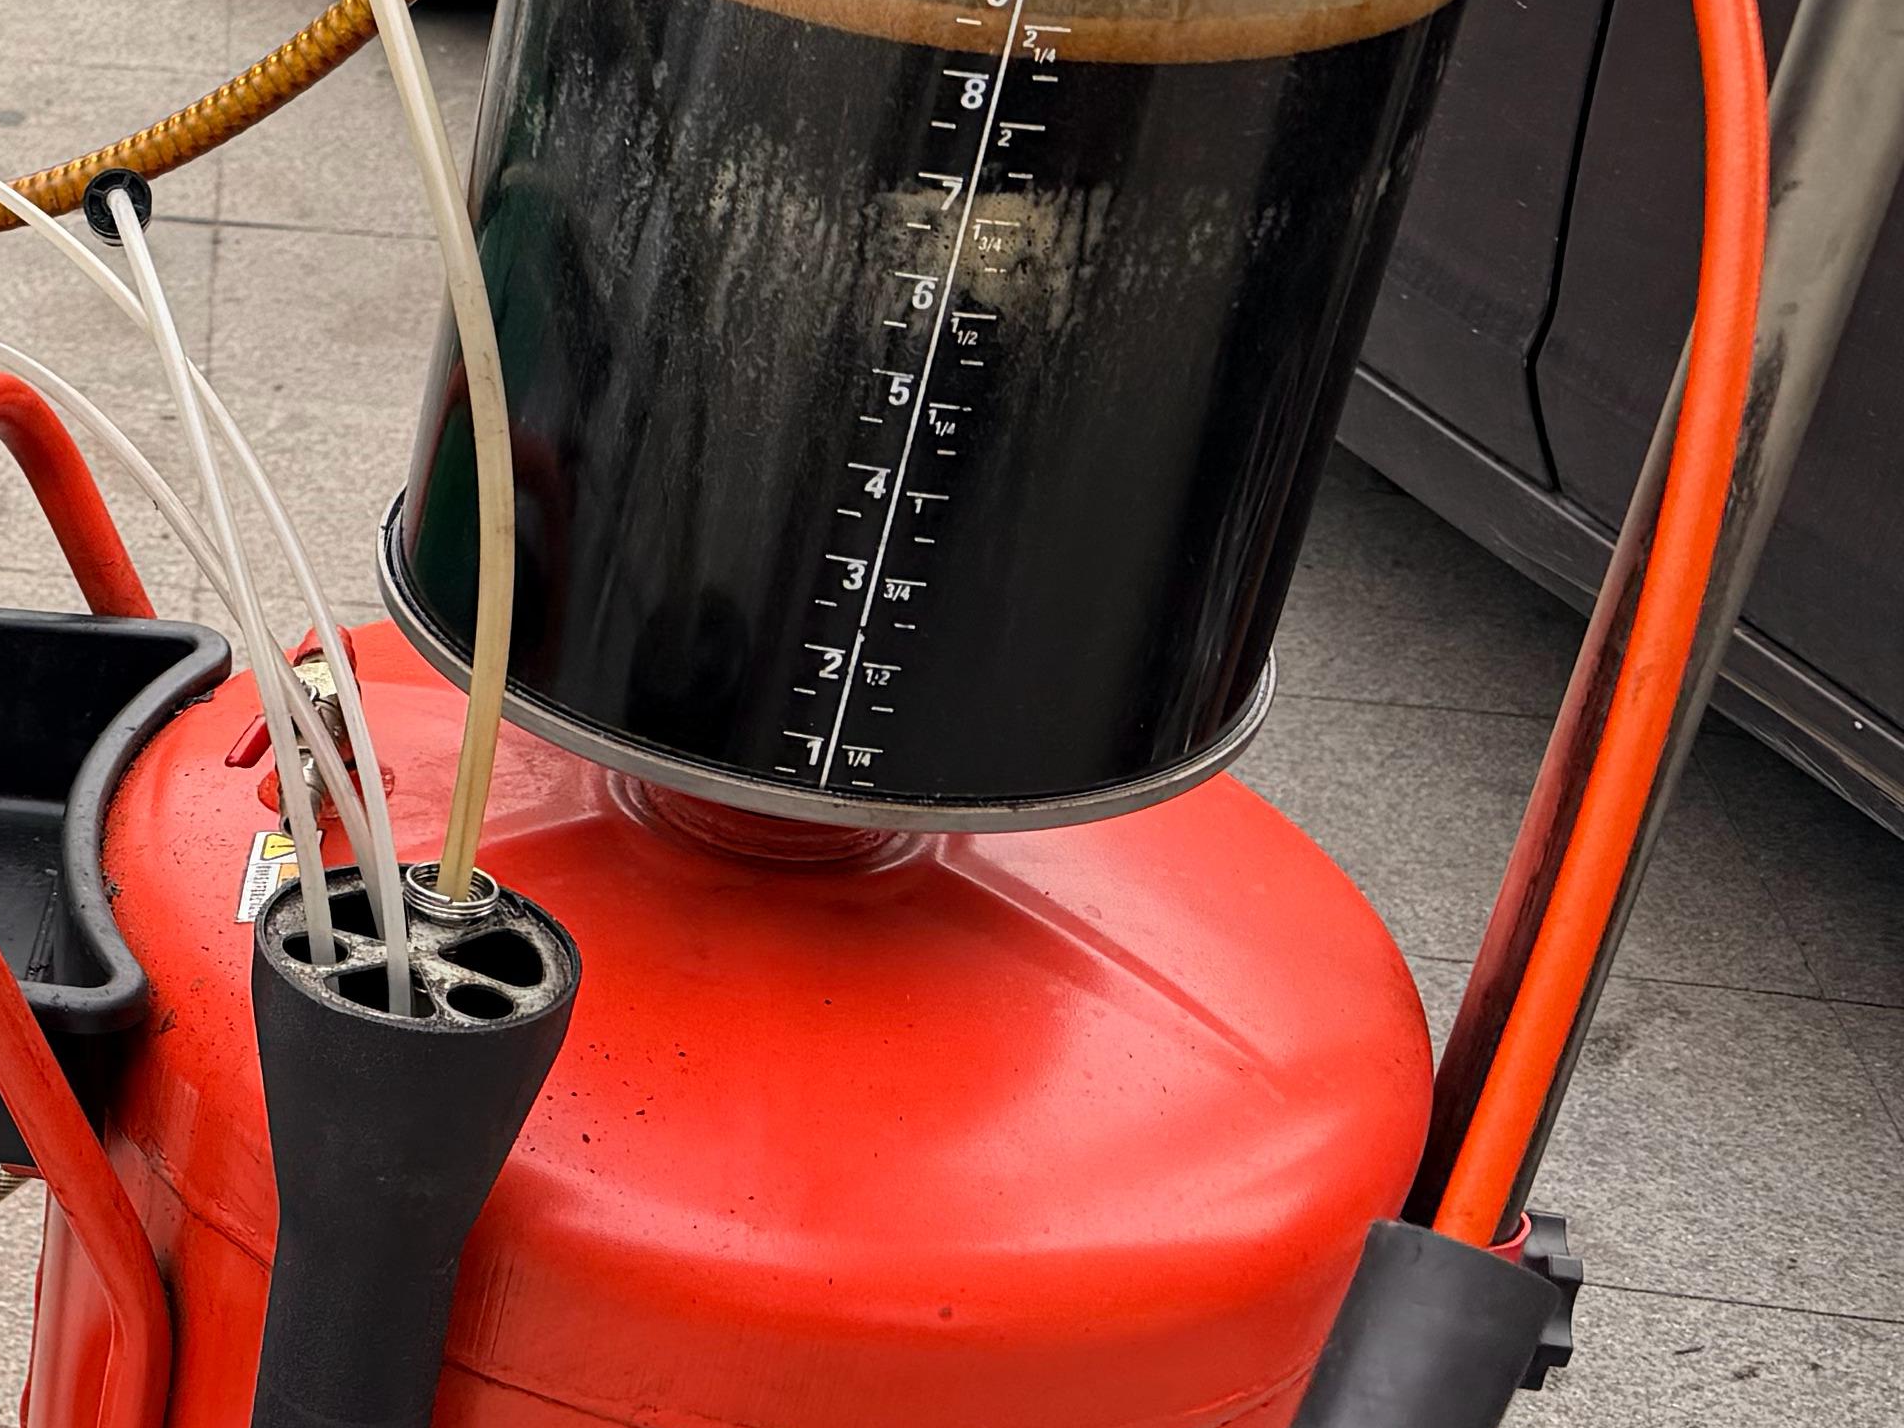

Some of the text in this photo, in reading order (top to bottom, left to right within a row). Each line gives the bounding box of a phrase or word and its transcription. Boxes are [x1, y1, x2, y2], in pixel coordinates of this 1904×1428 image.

[960, 79, 987, 110] 8
[997, 129, 1012, 147] 2
[941, 179, 964, 211] 7
[912, 281, 935, 311] 6
[887, 376, 912, 406] 5
[864, 469, 887, 500] 4
[914, 498, 923, 514] 1
[842, 562, 866, 591] 3
[883, 582, 911, 601] 3/4
[818, 653, 843, 679] 2
[806, 740, 822, 766] 1
[847, 749, 872, 768] 1/4
